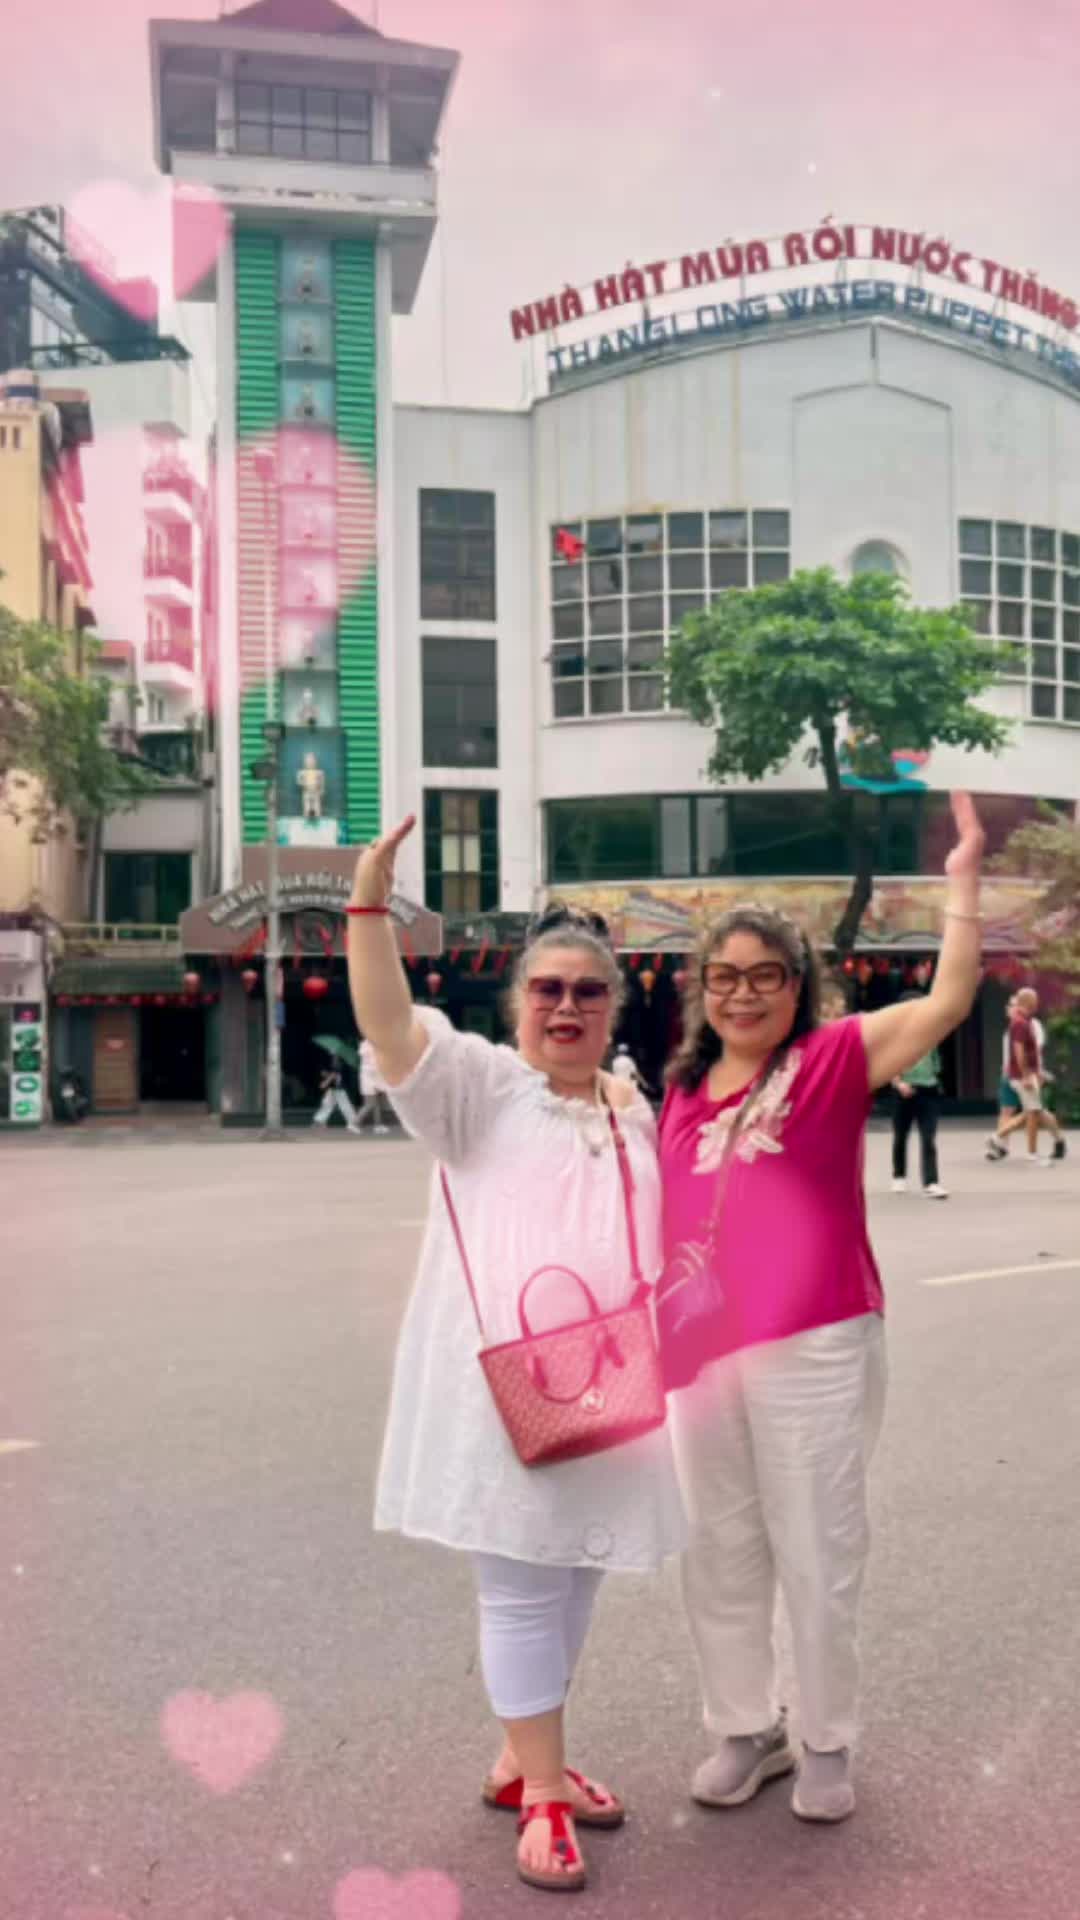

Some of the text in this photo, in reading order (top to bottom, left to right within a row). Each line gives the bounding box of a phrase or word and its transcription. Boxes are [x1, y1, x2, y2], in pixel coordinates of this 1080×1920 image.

[511, 283, 584, 340] NHÀ
[594, 260, 667, 310] HÁT
[777, 280, 896, 319] WATER
[904, 286, 1031, 349] PUPPET
